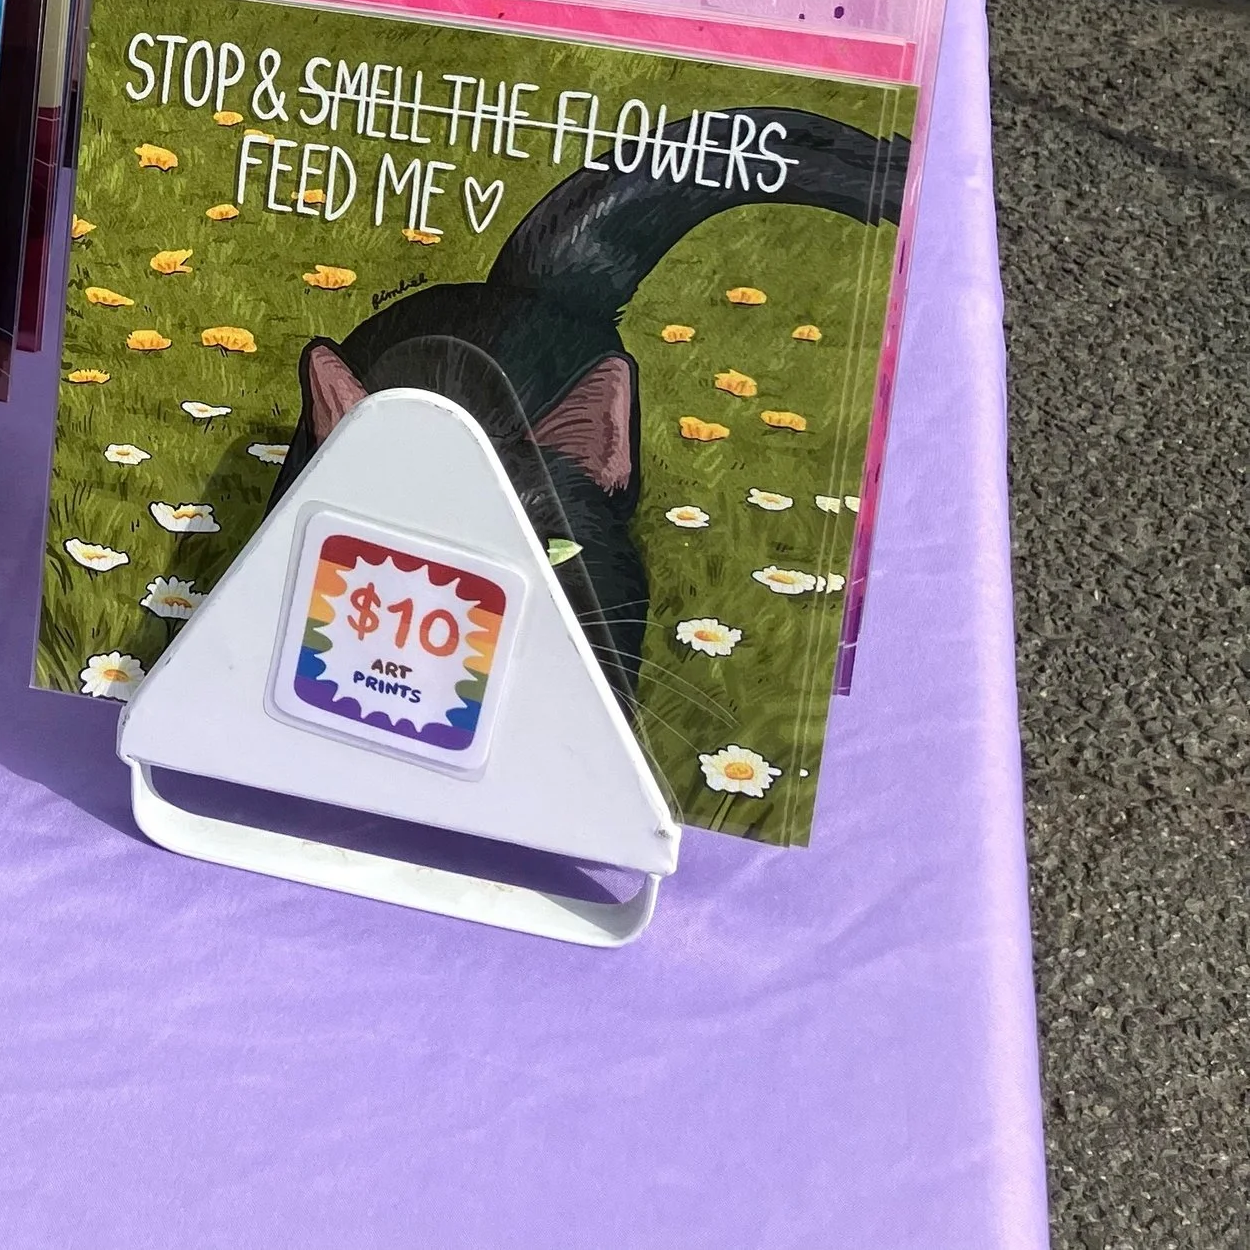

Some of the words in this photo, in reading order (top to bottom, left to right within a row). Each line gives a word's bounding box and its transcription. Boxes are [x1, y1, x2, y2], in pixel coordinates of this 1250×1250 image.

[126, 32, 247, 110] STOP
[252, 48, 288, 124] &
[301, 56, 432, 145] SMELL
[443, 73, 540, 159] THE
[552, 90, 791, 194] FLOWERS
[236, 134, 356, 222] FEED
[375, 152, 455, 236] ME
[347, 582, 460, 657] $10
[352, 670, 422, 704] PRINTS
[371, 658, 412, 679] ART
